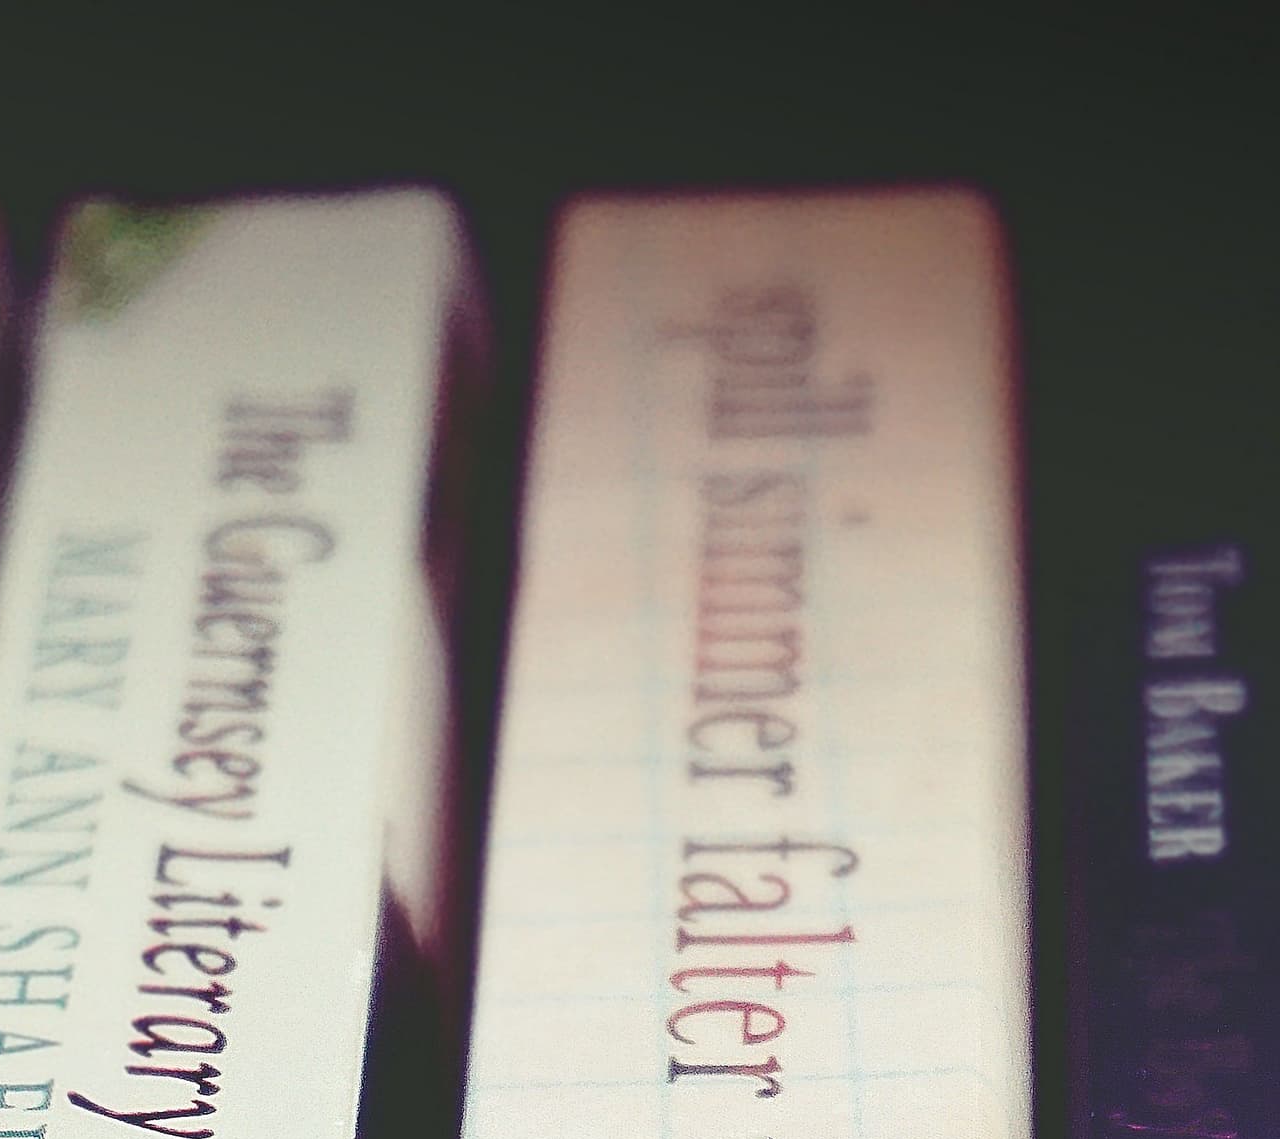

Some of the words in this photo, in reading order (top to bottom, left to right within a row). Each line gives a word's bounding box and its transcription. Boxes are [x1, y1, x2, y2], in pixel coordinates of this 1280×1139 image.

[215, 385, 356, 495] The
[653, 283, 876, 440] spill
[27, 530, 149, 711] MARY
[122, 515, 336, 820] Guernsey
[689, 472, 872, 796] simmer
[1146, 680, 1246, 861] BAKER
[66, 842, 294, 1139] Literary
[665, 837, 859, 1099] falter
